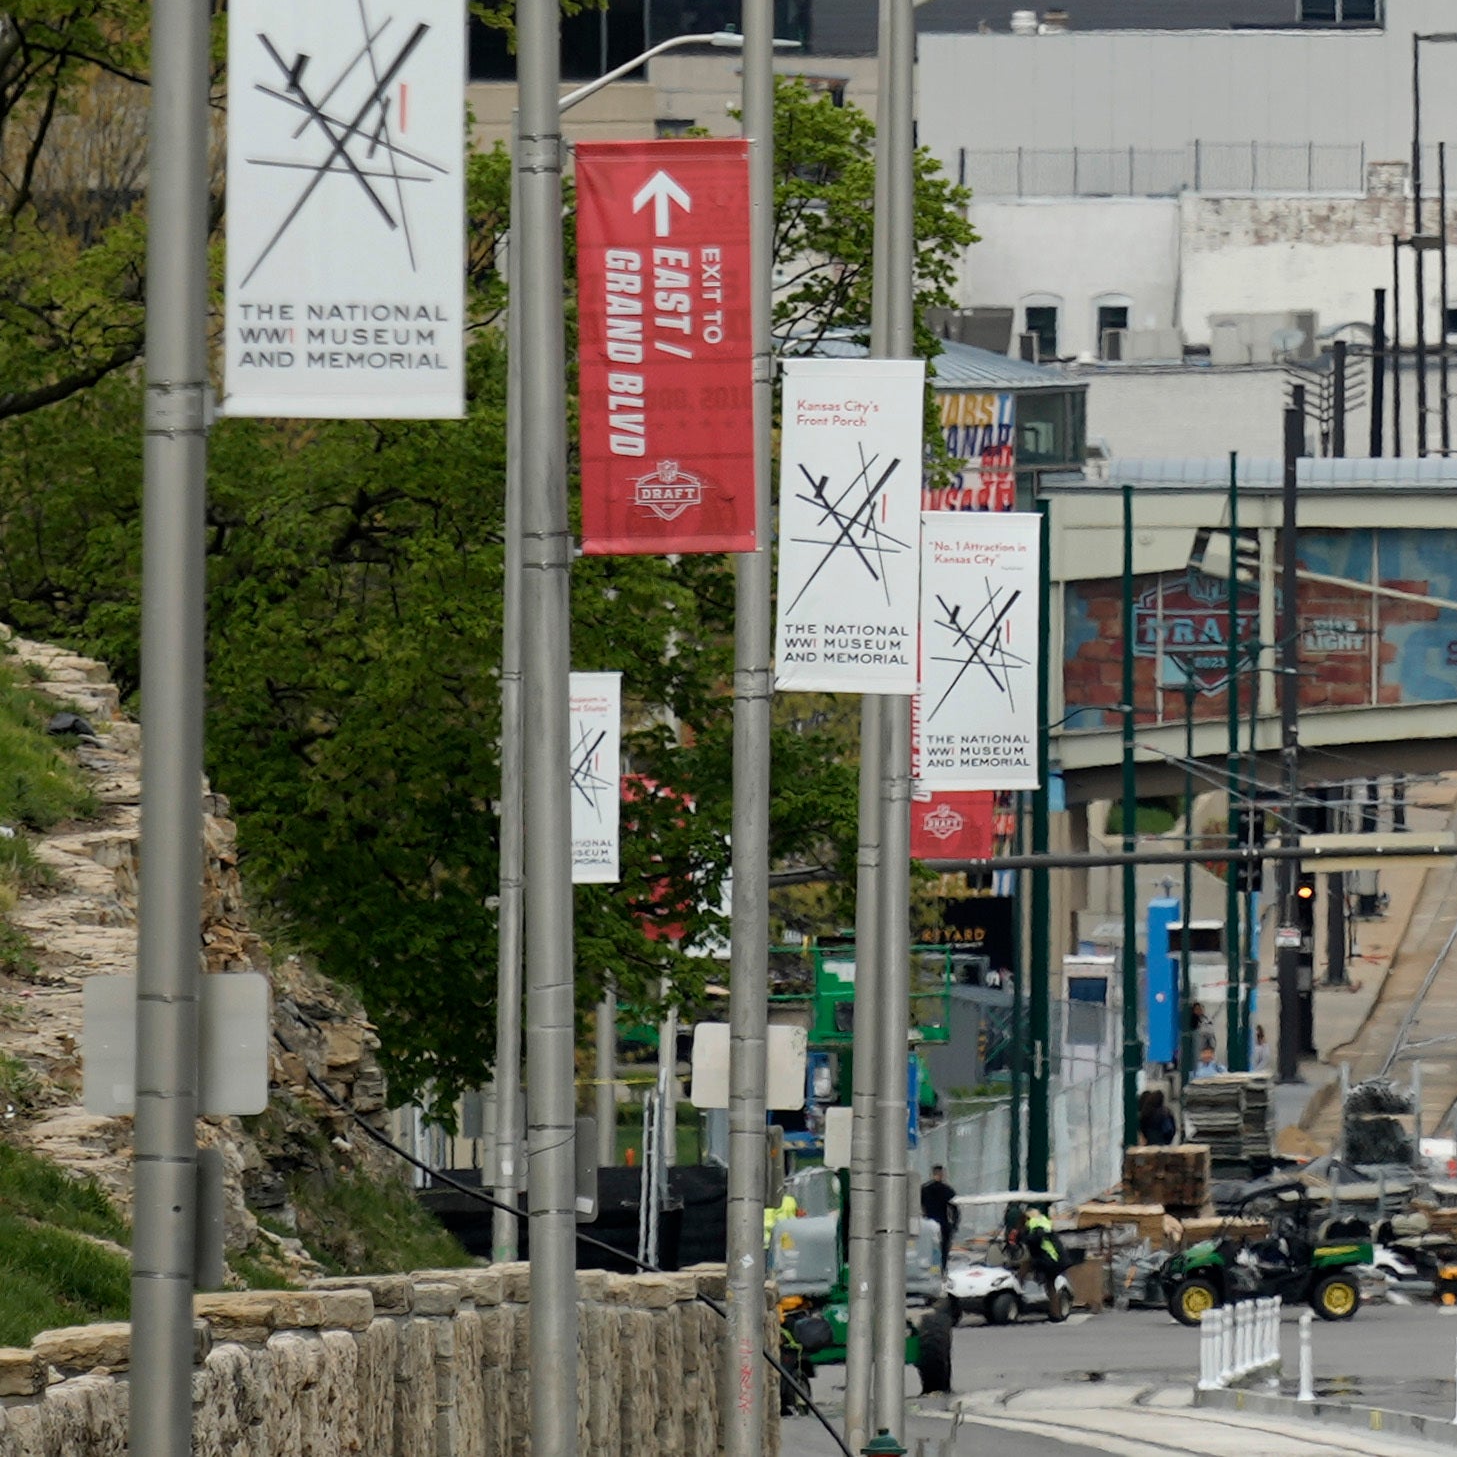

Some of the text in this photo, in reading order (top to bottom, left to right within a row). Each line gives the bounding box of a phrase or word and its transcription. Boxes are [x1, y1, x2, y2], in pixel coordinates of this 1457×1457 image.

[652, 247, 693, 336] EAST
[700, 247, 724, 345] EXIT TO
[239, 304, 448, 322] THE NATIONAL
[239, 328, 435, 346] WWI MUSEUM
[605, 248, 646, 458] GRAND BLVD
[239, 351, 448, 370] AND MEMORIAL
[797, 399, 841, 412] Kansas
[797, 414, 867, 427] Front Porch
[641, 488, 695, 499] DRAFT
[963, 542, 1016, 552] Attraction
[1017, 542, 1027, 552] in
[934, 553, 971, 564] Kansas
[785, 624, 909, 637] THE NATIONAL
[784, 638, 902, 651] WWI MUSEUM
[784, 652, 909, 666] AND MEMORIAL
[927, 735, 1030, 744] THE NATIONAL
[927, 747, 1025, 756] WWI MUSEUM
[927, 758, 1031, 768] AND MEMORIAL
